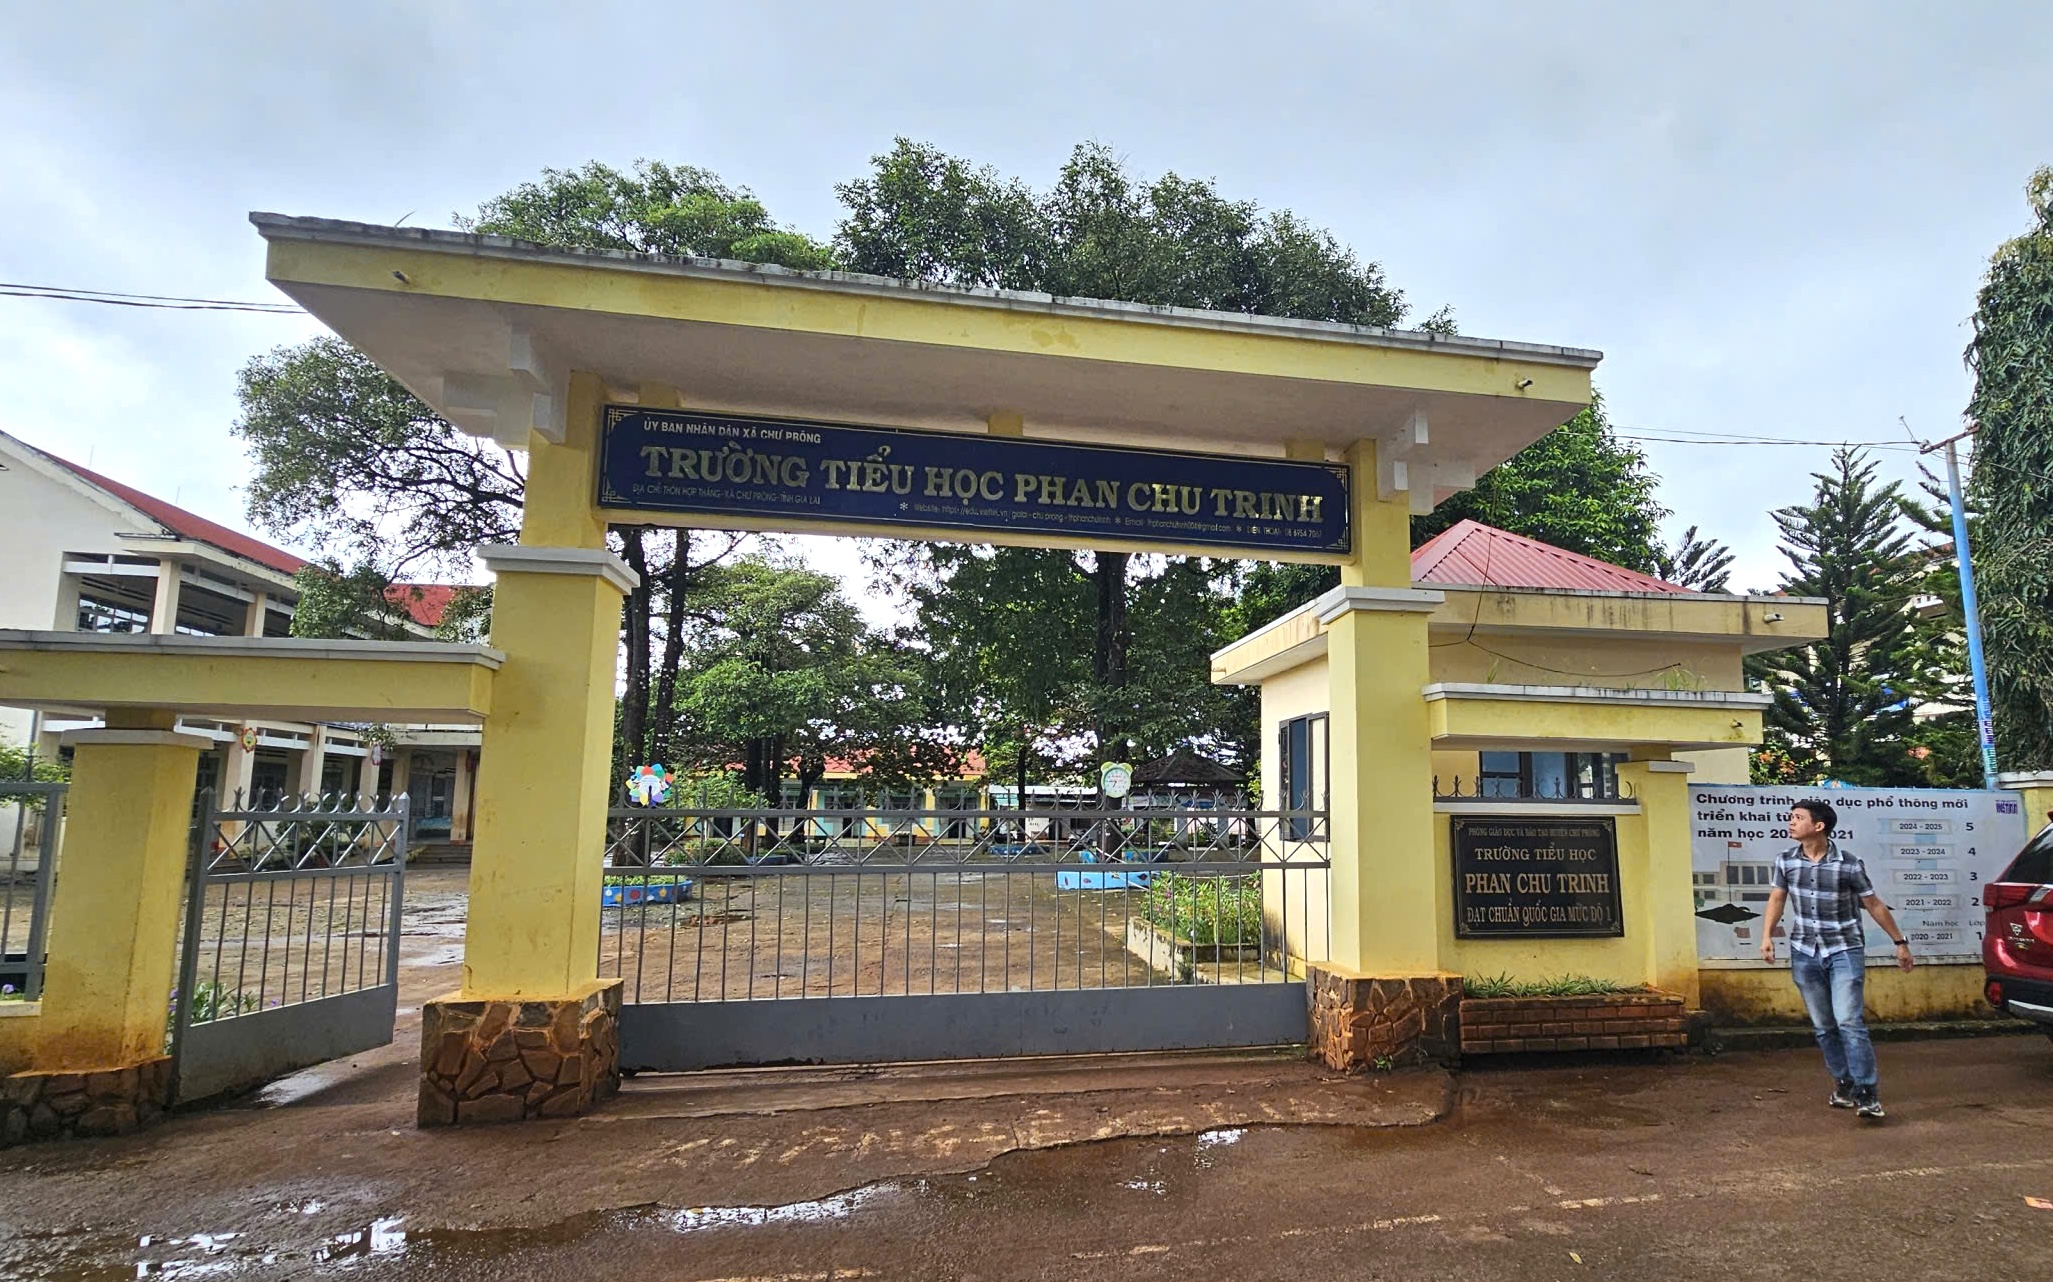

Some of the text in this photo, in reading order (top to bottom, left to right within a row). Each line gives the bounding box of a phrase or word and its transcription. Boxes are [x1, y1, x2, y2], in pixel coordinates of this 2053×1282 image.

[643, 416, 822, 444] ỦY BAN NHÂN DÂN XÃ CHƯ PRÔNG
[640, 440, 1324, 524] TRƯỜNG TIỂU HỌC PHAN CHU TRINH
[663, 484, 681, 496] THÔN
[682, 486, 698, 498] HỢP
[795, 493, 808, 504] GIA
[809, 495, 821, 506] LAI
[1696, 793, 1755, 807] Chương
[1835, 797, 1862, 809] dục
[1866, 795, 1894, 811] phổ
[1899, 798, 1938, 810] thông
[1942, 798, 1969, 809] mới
[1697, 808, 1793, 822] triển khai từ
[1965, 822, 1974, 831] 5
[1697, 827, 1732, 839] năm
[1738, 828, 1765, 841] học
[1474, 841, 1597, 864] TRƯỜNG TIỂU HỌC
[1967, 847, 1976, 856] 4
[1465, 873, 1610, 894] PHAN CHU TRINH
[1969, 872, 1978, 881] 3
[1971, 897, 1980, 906] 2
[1466, 897, 1612, 927] ĐẠT CHUẨN QUỐC GIA MỨC ĐỘ 1
[1936, 932, 1953, 940] 2021
[1976, 931, 1983, 941] 1
